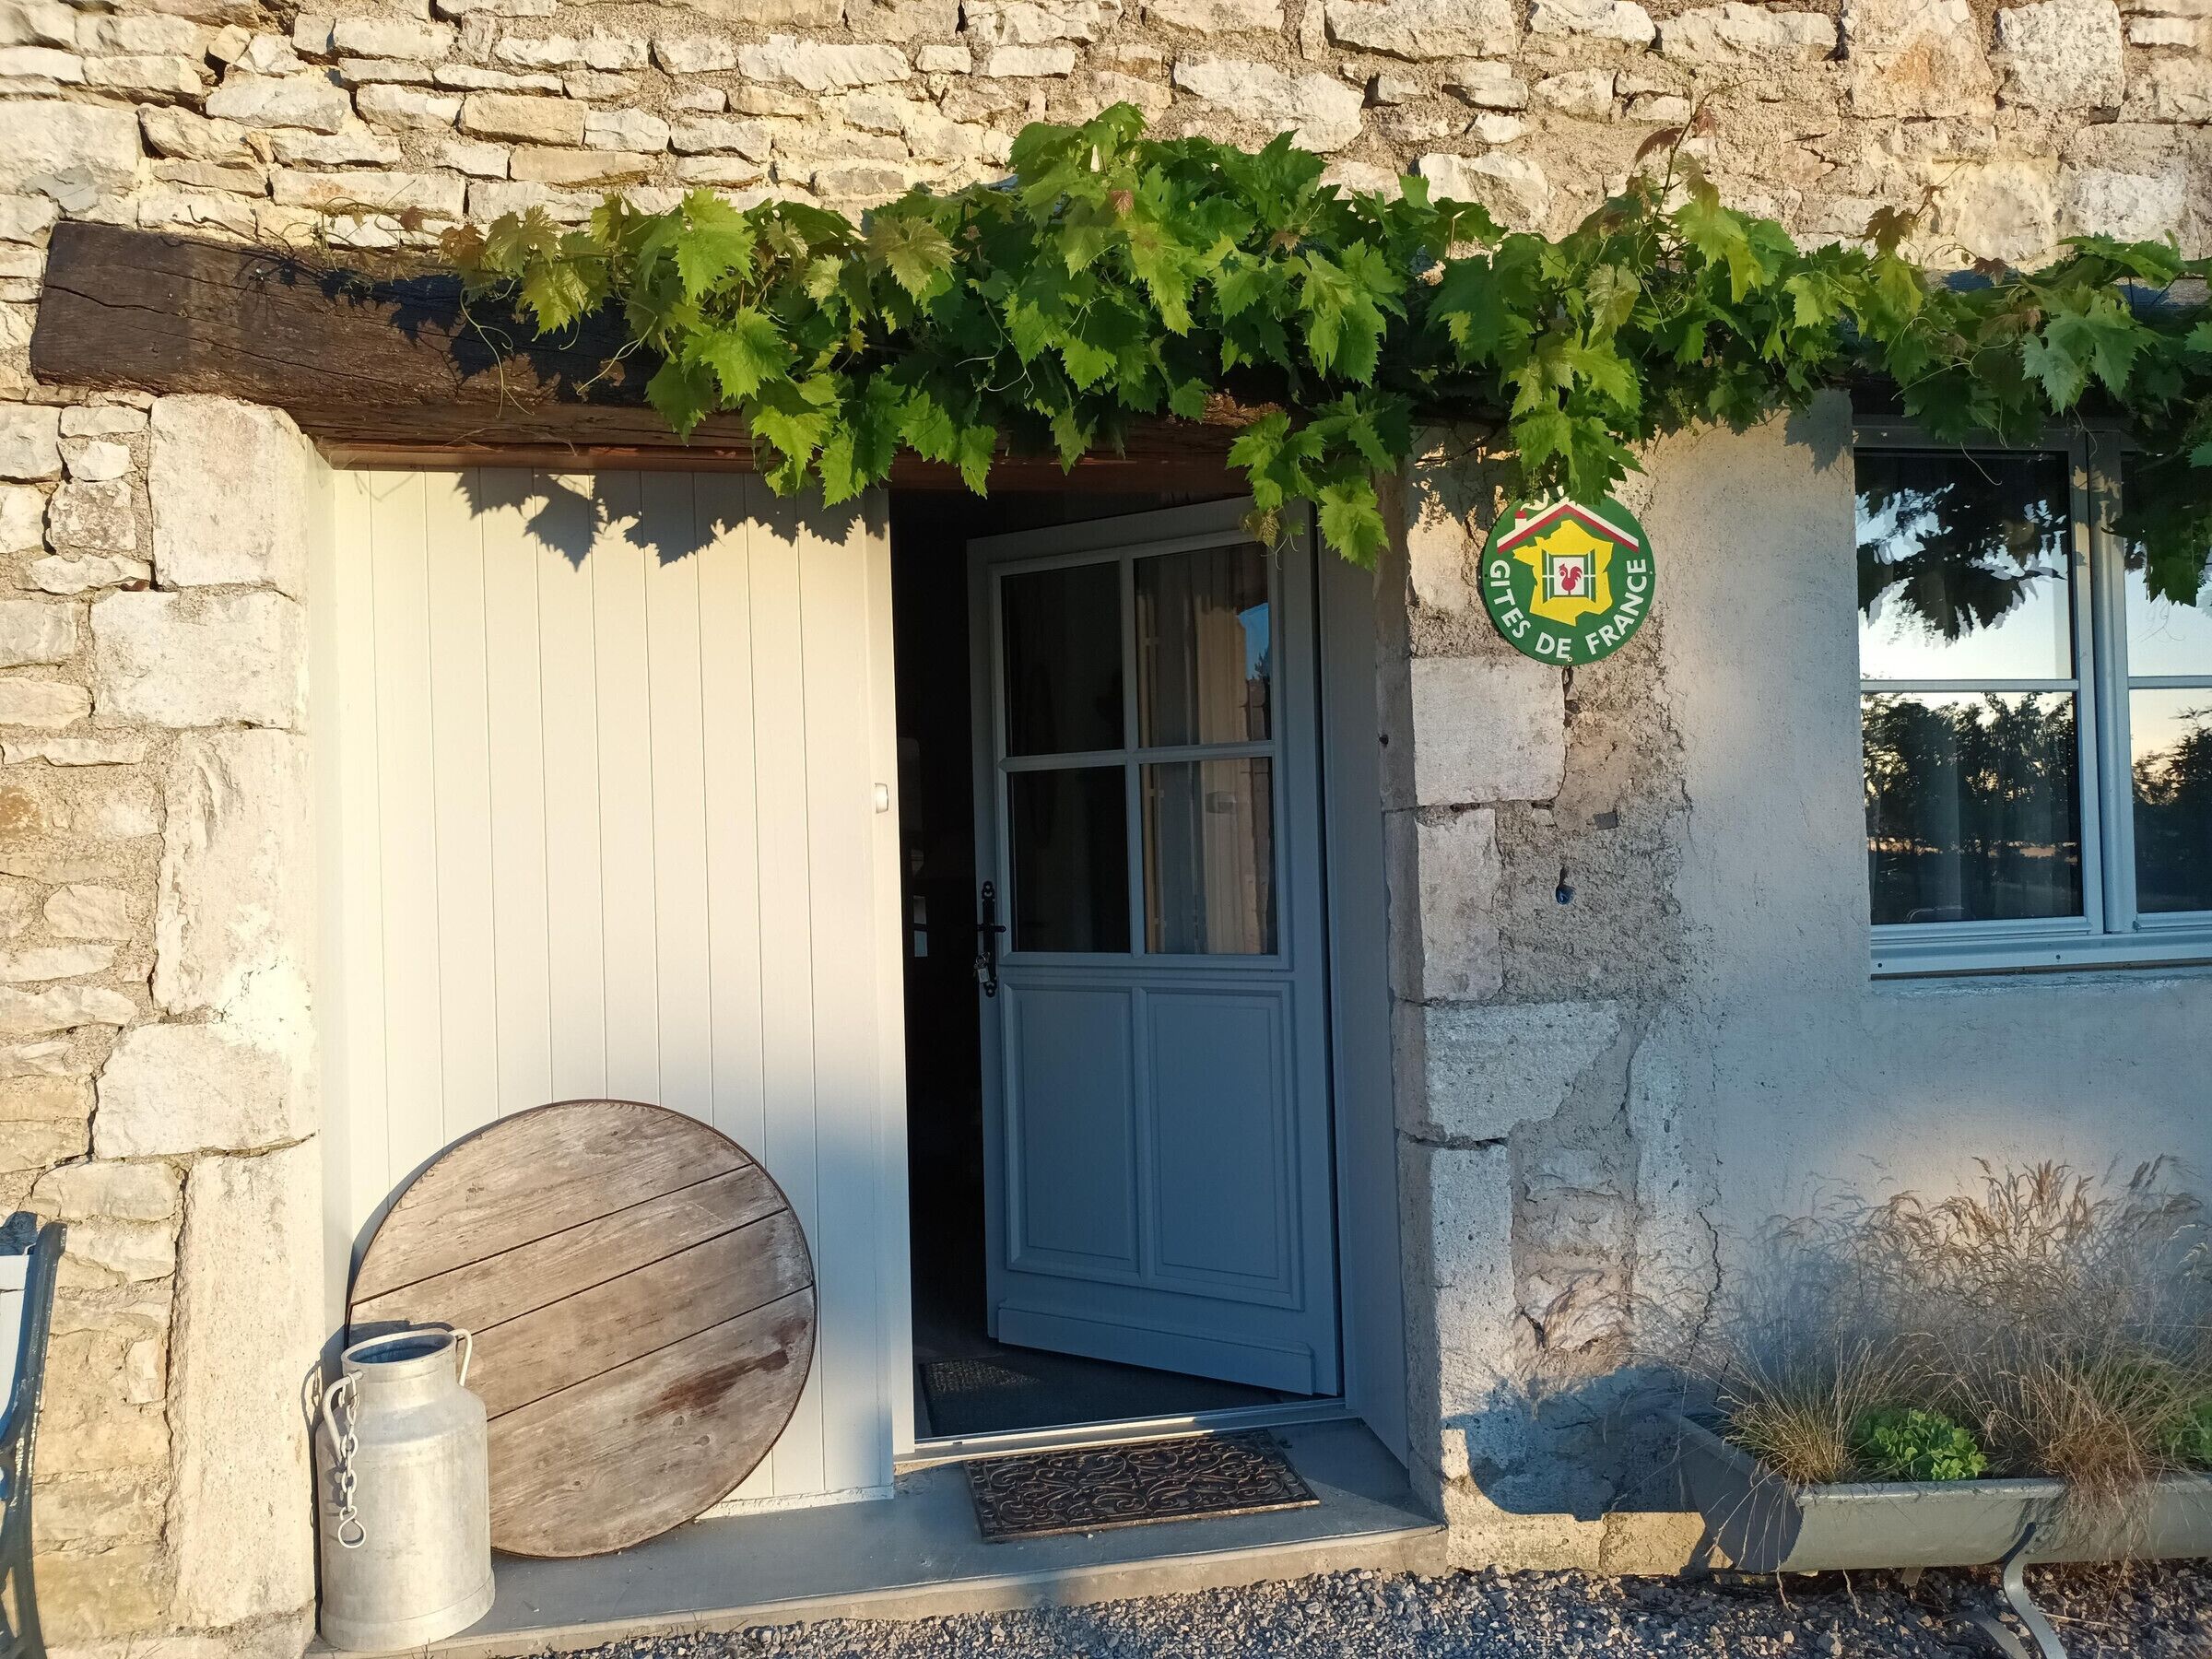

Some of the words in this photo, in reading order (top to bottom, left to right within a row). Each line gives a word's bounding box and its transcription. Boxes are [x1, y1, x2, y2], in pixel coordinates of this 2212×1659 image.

[1489, 559, 1531, 638] GITES
[1535, 631, 1571, 659] DE
[1584, 559, 1648, 655] FRANCE
